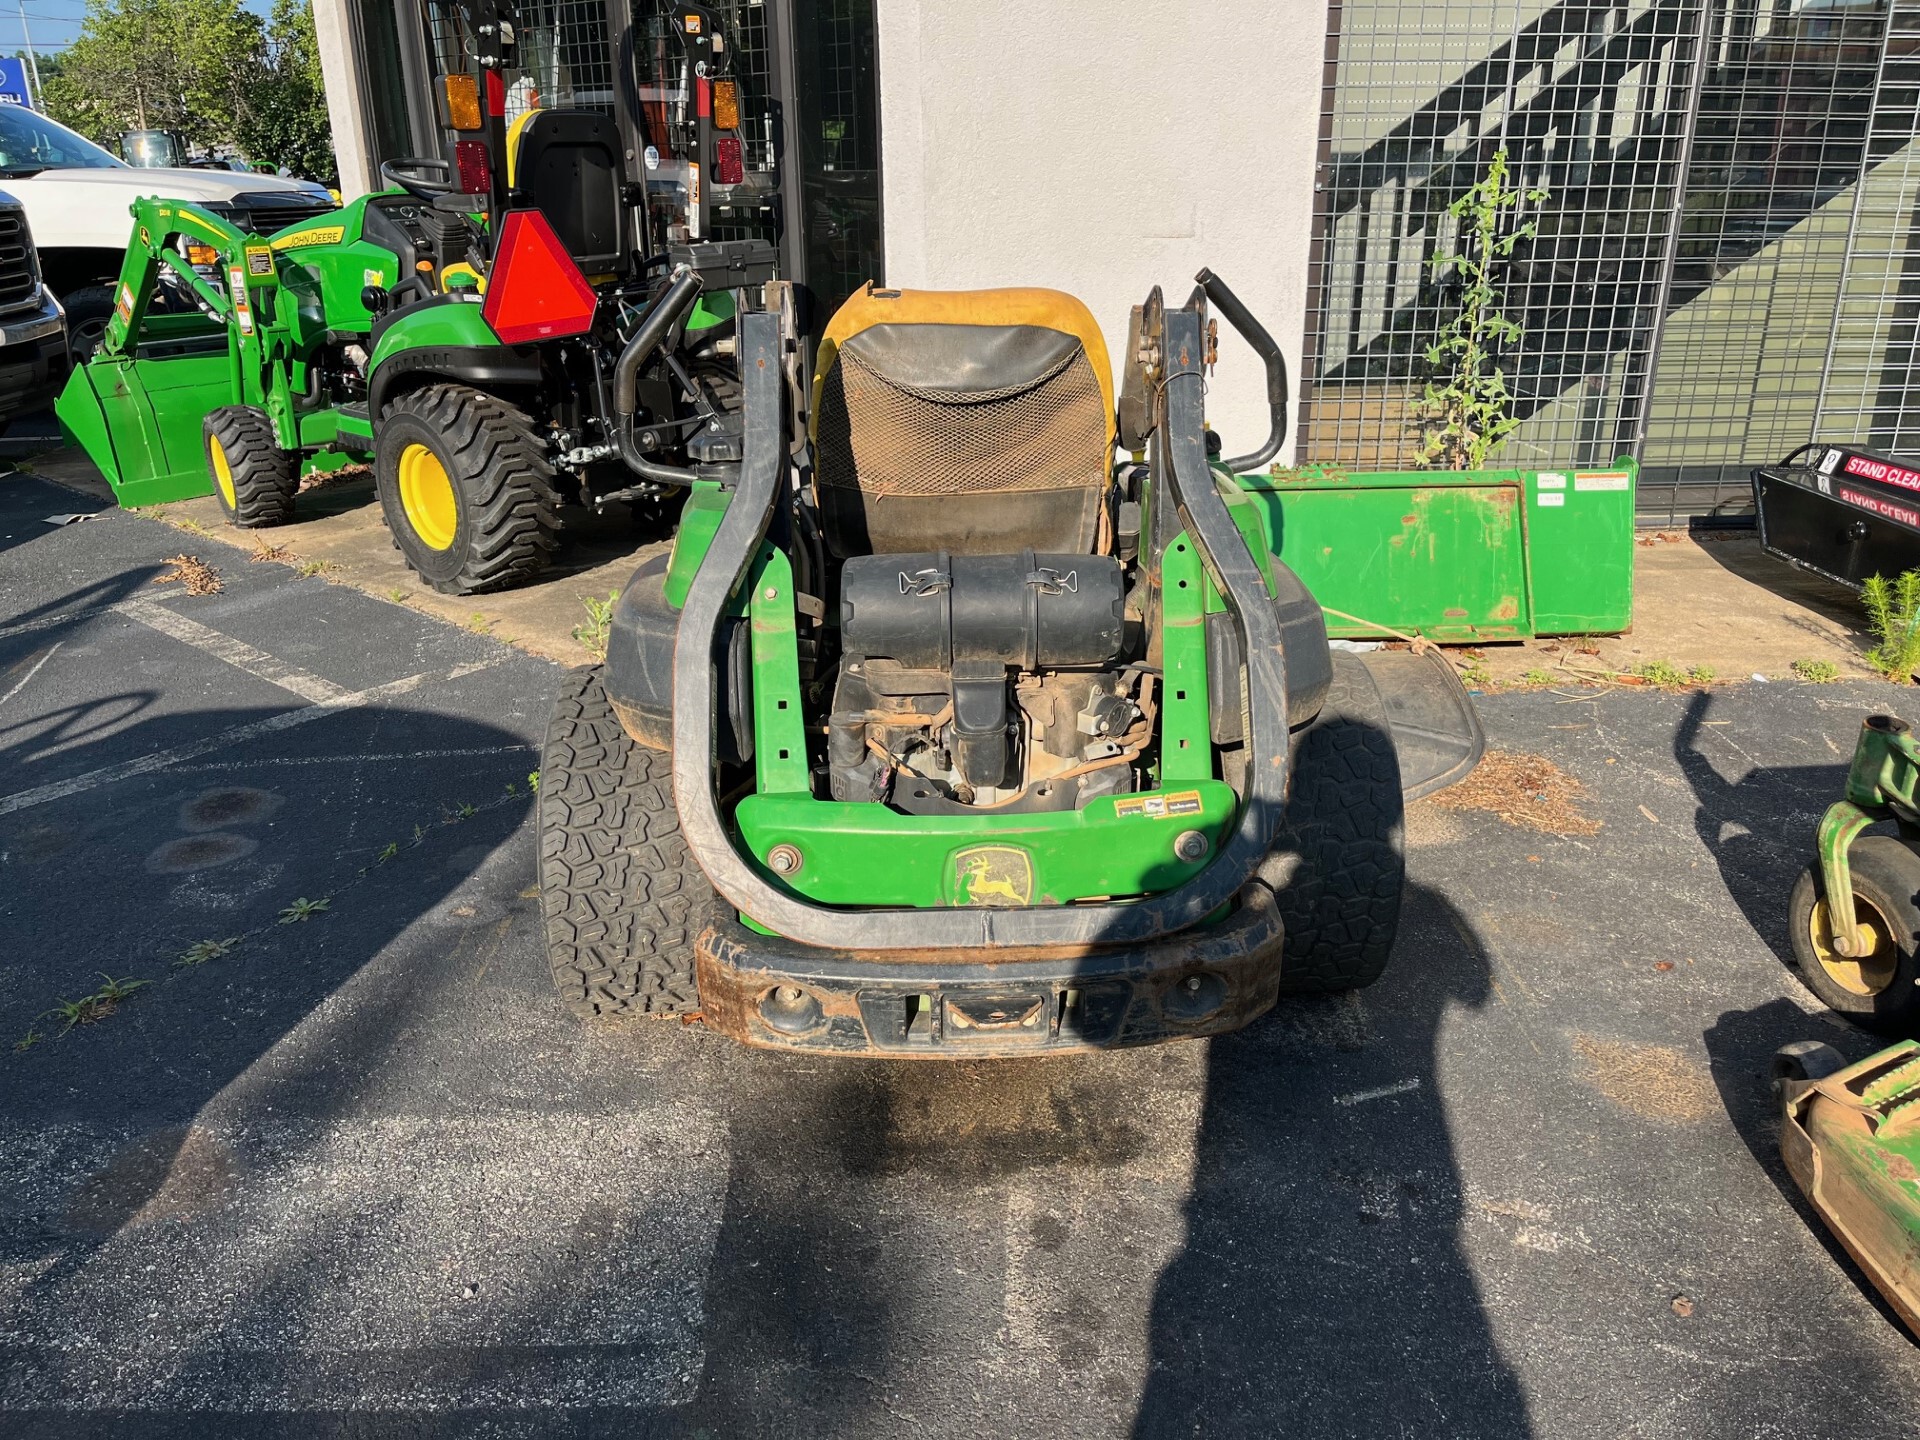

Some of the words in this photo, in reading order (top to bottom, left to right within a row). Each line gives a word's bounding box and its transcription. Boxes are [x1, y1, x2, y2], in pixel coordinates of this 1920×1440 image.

[289, 235, 309, 246] JOHN
[311, 232, 338, 243] DEERE
[1848, 458, 1886, 479] STAND
